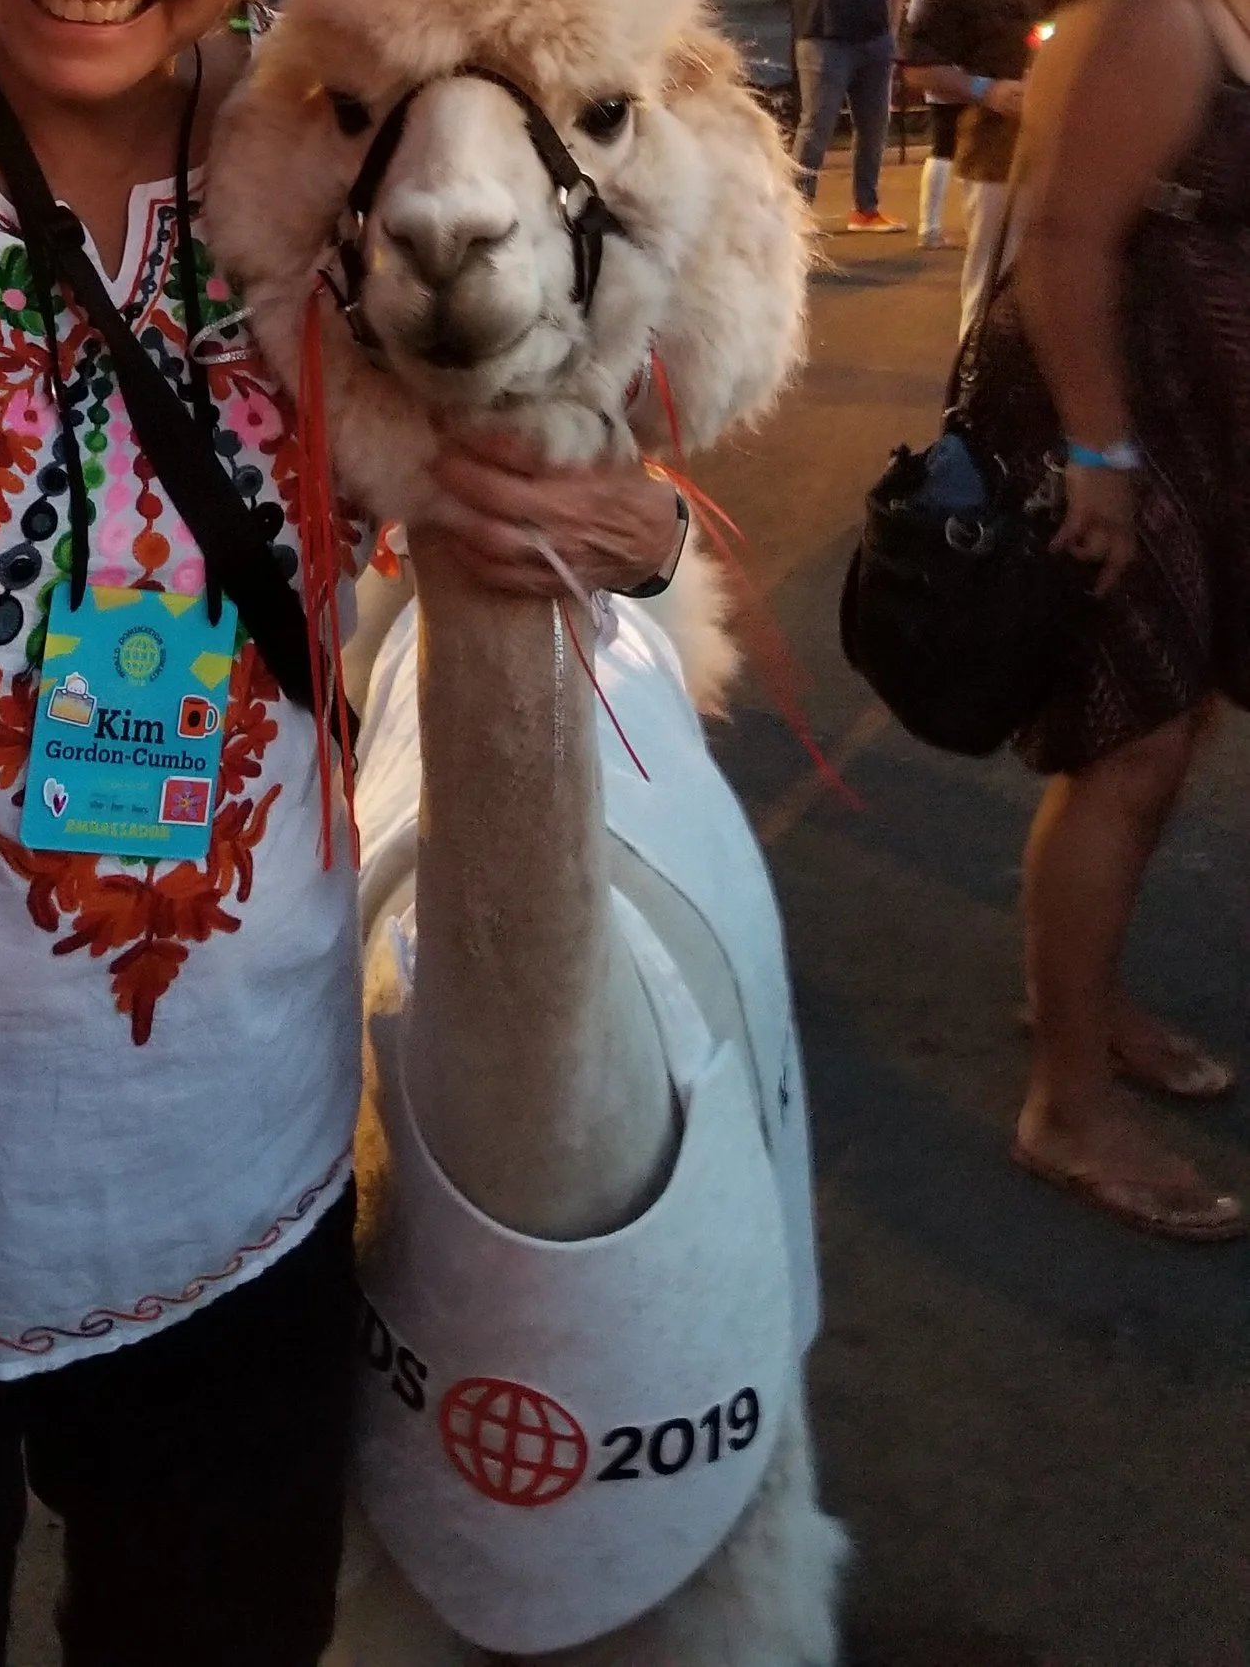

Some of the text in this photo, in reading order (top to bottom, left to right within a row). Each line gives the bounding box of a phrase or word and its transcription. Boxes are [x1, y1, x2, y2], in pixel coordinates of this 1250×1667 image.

[94, 707, 165, 745] Kim
[45, 739, 206, 771] Gordon-Cumbo
[597, 1386, 760, 1482] 2019
